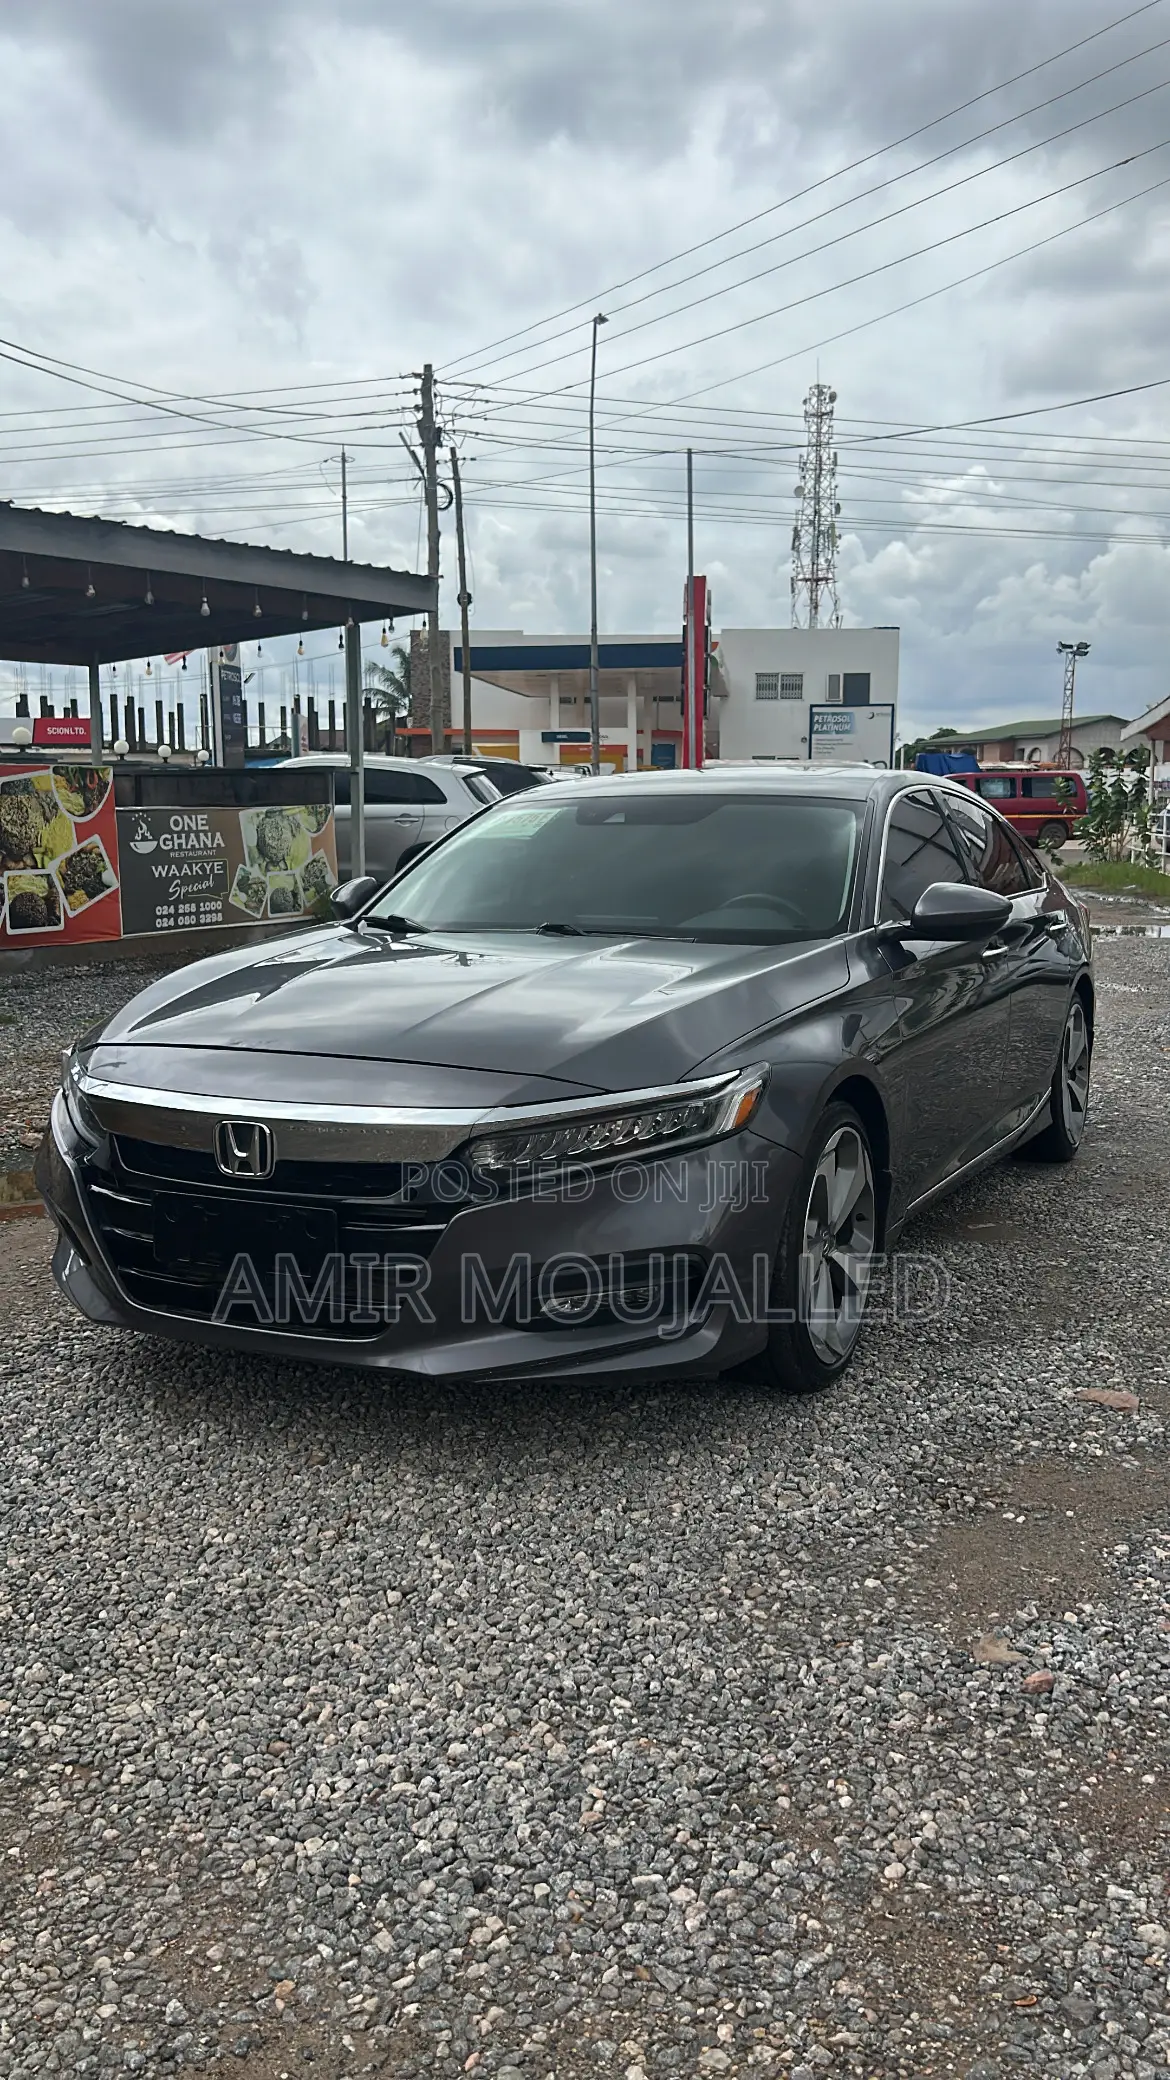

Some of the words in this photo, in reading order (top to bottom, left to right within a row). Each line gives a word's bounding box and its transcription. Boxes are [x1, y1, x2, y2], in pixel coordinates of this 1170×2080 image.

[813, 714, 851, 723] PETROSOL
[47, 727, 70, 735] SCION
[70, 727, 87, 735] LTD.
[813, 722, 852, 732] PLATINUM
[169, 814, 209, 831] ONE
[159, 831, 226, 850] GHANA
[170, 849, 217, 858] RESTAURANT
[151, 861, 224, 878] WAAKYE
[168, 873, 215, 901] Special
[155, 905, 175, 916] 024
[199, 900, 223, 912] 1000
[155, 917, 175, 928] 024
